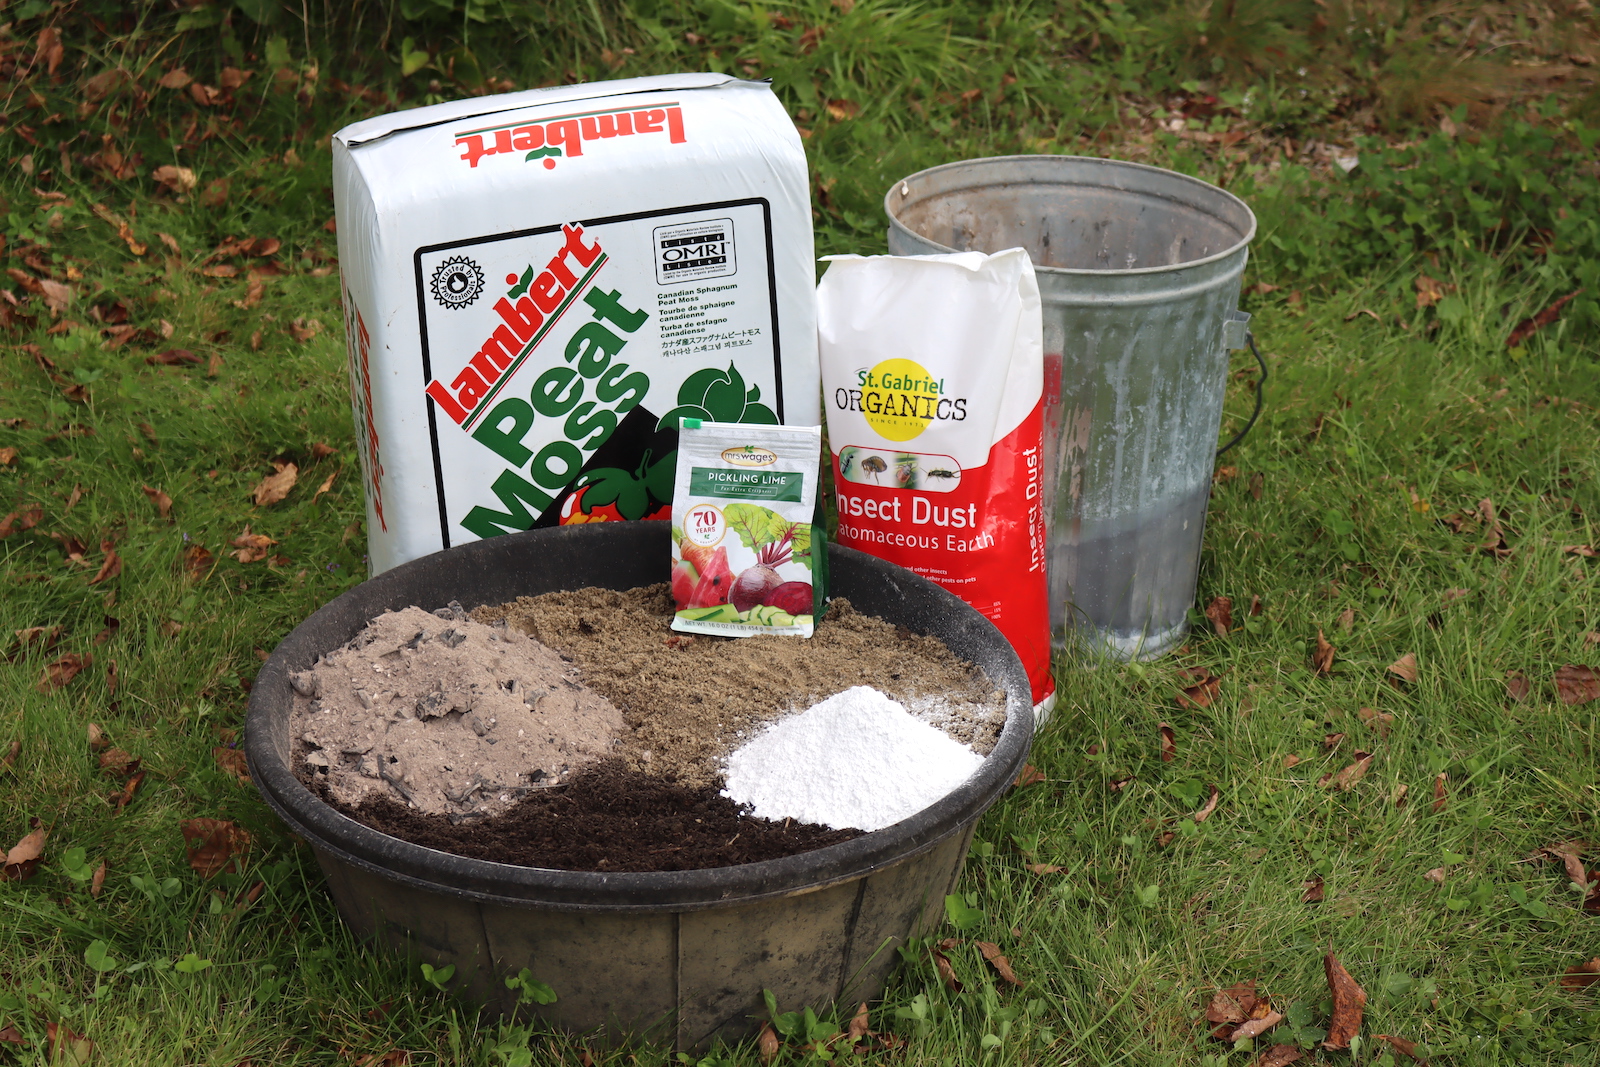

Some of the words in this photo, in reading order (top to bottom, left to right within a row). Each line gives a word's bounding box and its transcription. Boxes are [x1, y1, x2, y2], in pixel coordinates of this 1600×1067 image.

[455, 107, 687, 169] lambert
[662, 242, 726, 261] OMRI
[440, 265, 464, 283] Trusted
[466, 269, 474, 278] by
[440, 281, 476, 301] Professionals
[657, 290, 695, 300] Canadian
[696, 284, 738, 294] Sphagnum
[659, 306, 686, 316] Tourbe
[700, 300, 736, 310] sphaigne
[659, 311, 705, 323] canadienne
[425, 224, 602, 425] lambert
[660, 323, 683, 332] Turba
[696, 317, 728, 327] esfagno
[660, 327, 706, 339] canadiense
[471, 286, 649, 469] Peat
[858, 371, 879, 388] St.
[882, 373, 944, 394] Gabriel
[836, 388, 967, 421] ORGANICS
[459, 363, 650, 540] Moss
[741, 453, 773, 463] wages
[708, 472, 759, 484] PICKLING
[762, 475, 787, 485] LIME
[1022, 446, 1038, 500] Dust
[693, 510, 717, 527] 70
[912, 496, 977, 528] Dust
[695, 526, 716, 534] YEARS
[839, 523, 939, 550] atomaceous
[946, 531, 995, 552] Earth
[1028, 504, 1039, 572] Insect
[930, 567, 947, 575] insects
